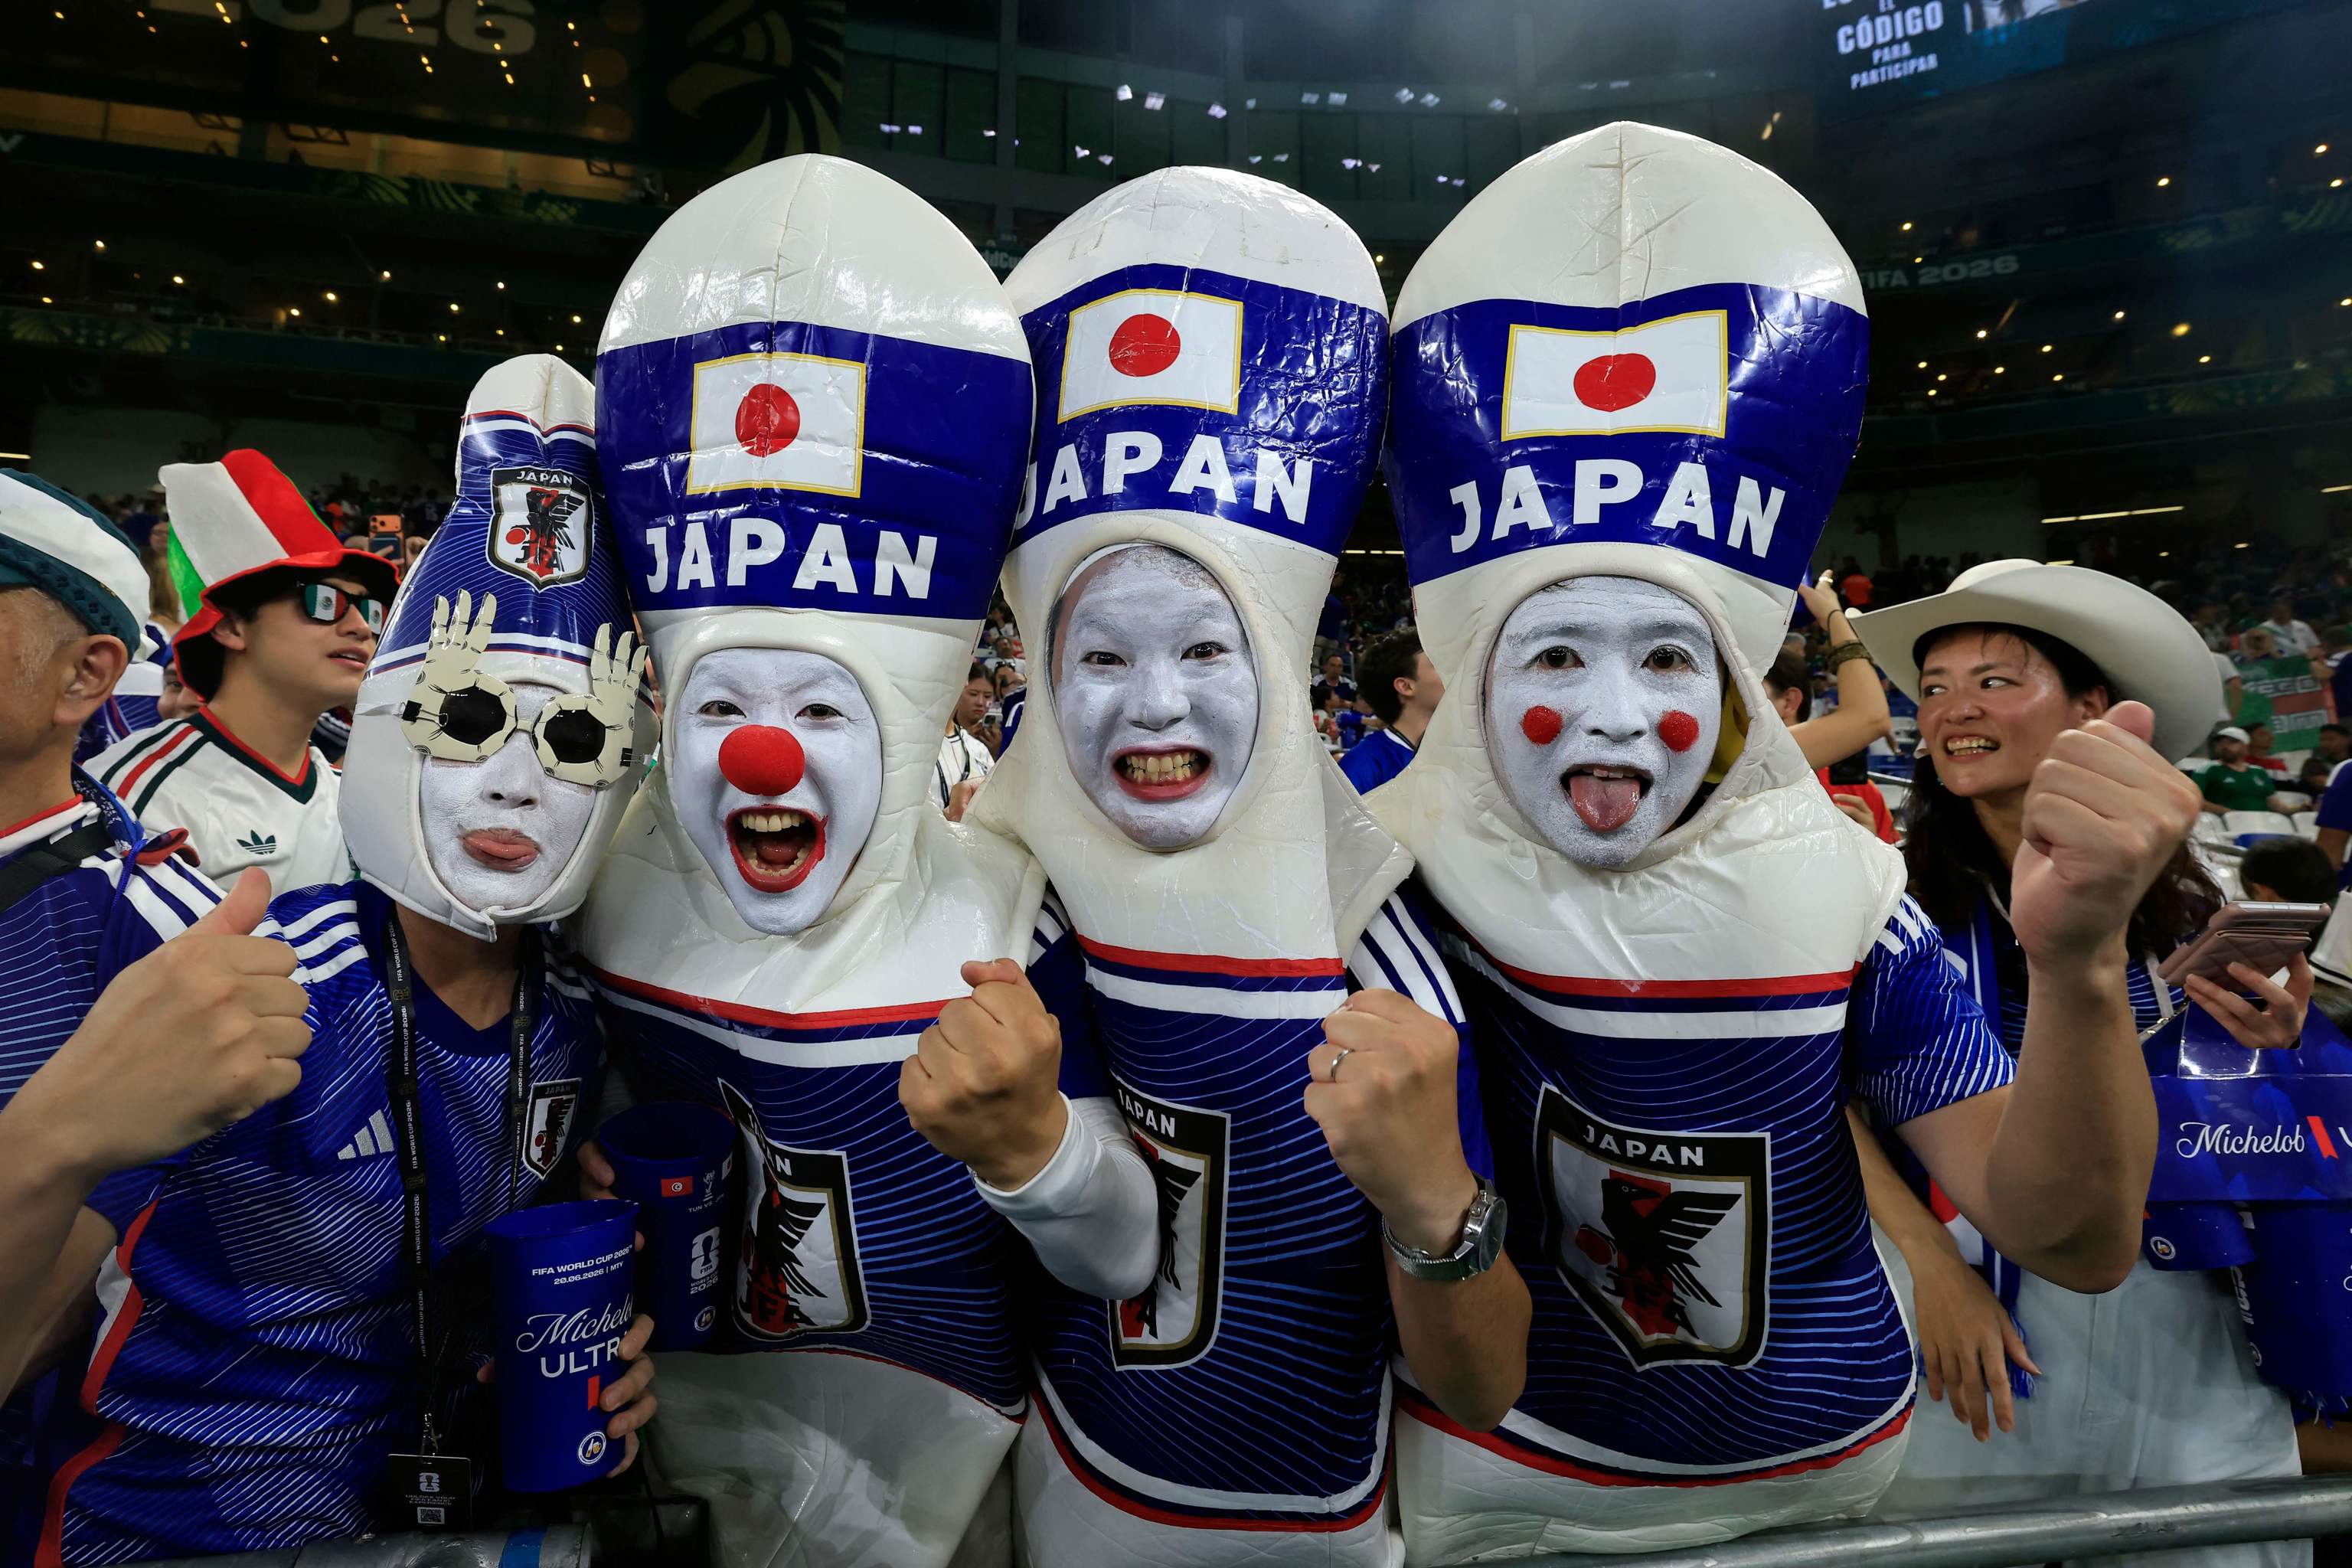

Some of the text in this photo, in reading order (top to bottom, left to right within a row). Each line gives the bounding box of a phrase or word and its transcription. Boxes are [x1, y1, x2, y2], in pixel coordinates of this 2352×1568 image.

[1838, 1, 1944, 54] CÓDIGO
[1872, 41, 1912, 65] PARA
[1851, 54, 1938, 90] PARTICIPAR
[1918, 255, 2019, 285] 2026
[517, 471, 573, 485] JAPAN
[1449, 459, 1786, 559] JAPAN
[646, 518, 938, 599] JAPAN
[1583, 1125, 1704, 1166] JAPAN
[2177, 1122, 2305, 1158] Michelob
[532, 1267, 555, 1276] FIFA
[557, 1259, 594, 1272] WORLD
[596, 1253, 613, 1265] CUP
[554, 1269, 604, 1285] 20.06.2026
[691, 1275, 710, 1287] WORLD
[690, 1276, 719, 1295] 2026
[541, 1331, 628, 1378] ULTR
